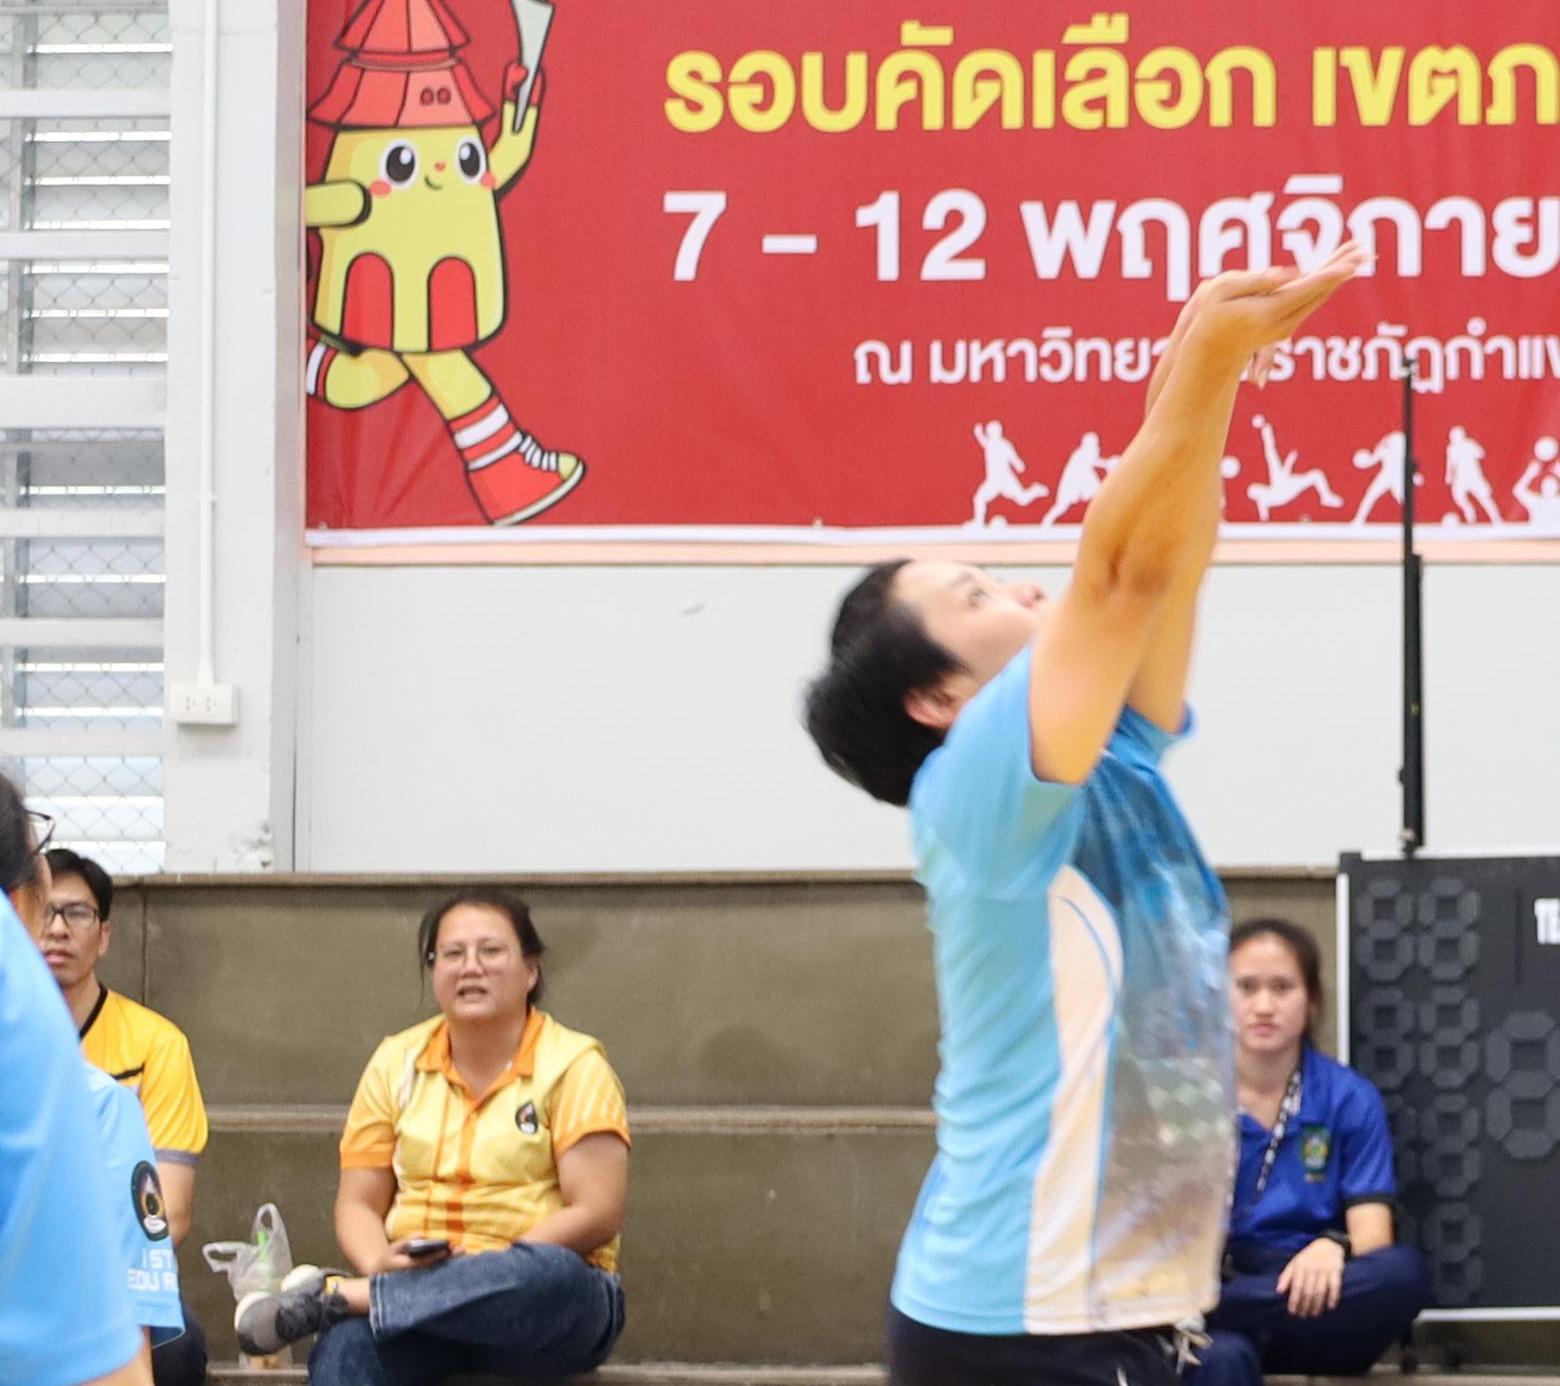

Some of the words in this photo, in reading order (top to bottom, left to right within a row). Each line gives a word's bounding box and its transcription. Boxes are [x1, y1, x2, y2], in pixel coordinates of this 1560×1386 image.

[664, 13, 1277, 132] รอบคัดเลือก
[664, 191, 727, 281] 7
[855, 189, 987, 281] 12
[854, 341, 912, 384] ณ
